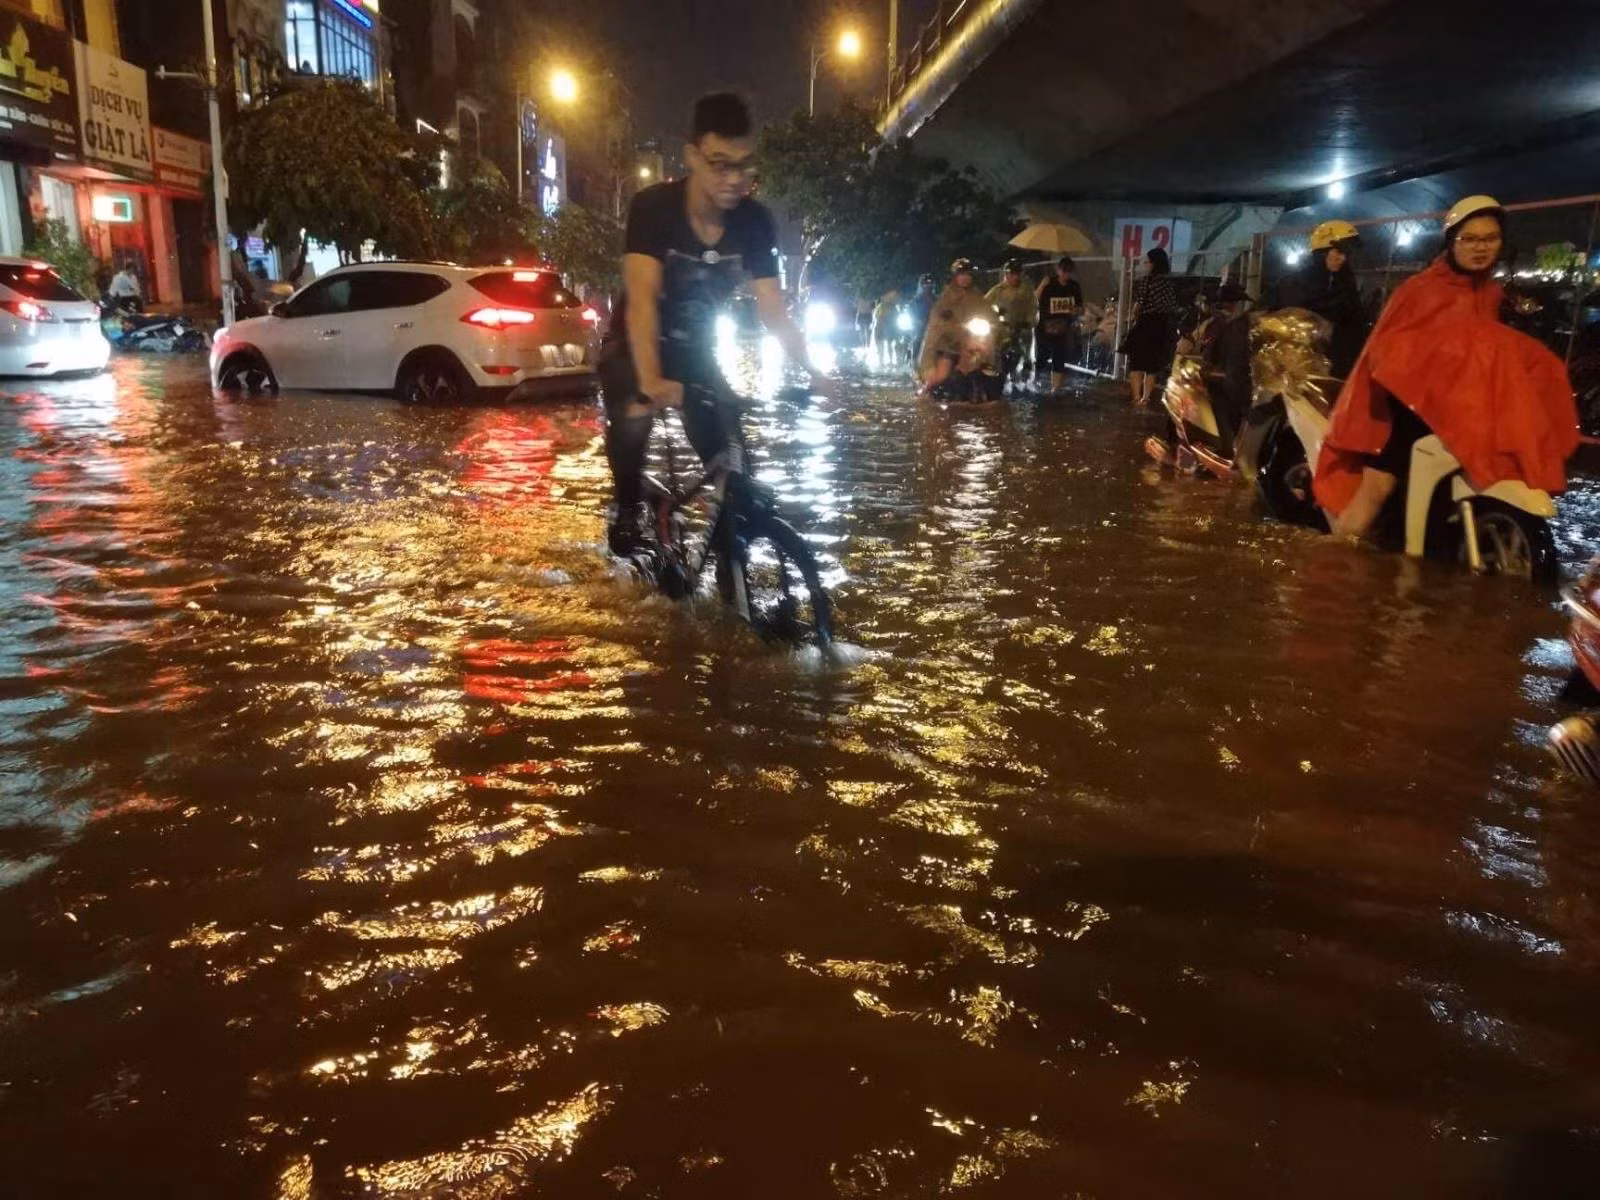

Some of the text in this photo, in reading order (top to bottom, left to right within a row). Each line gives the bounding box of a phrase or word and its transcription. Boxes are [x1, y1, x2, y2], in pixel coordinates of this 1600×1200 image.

[91, 85, 123, 113] DỊCH
[125, 98, 142, 124] VỤ
[85, 115, 125, 158] GIẶT
[129, 128, 150, 162] LÀ
